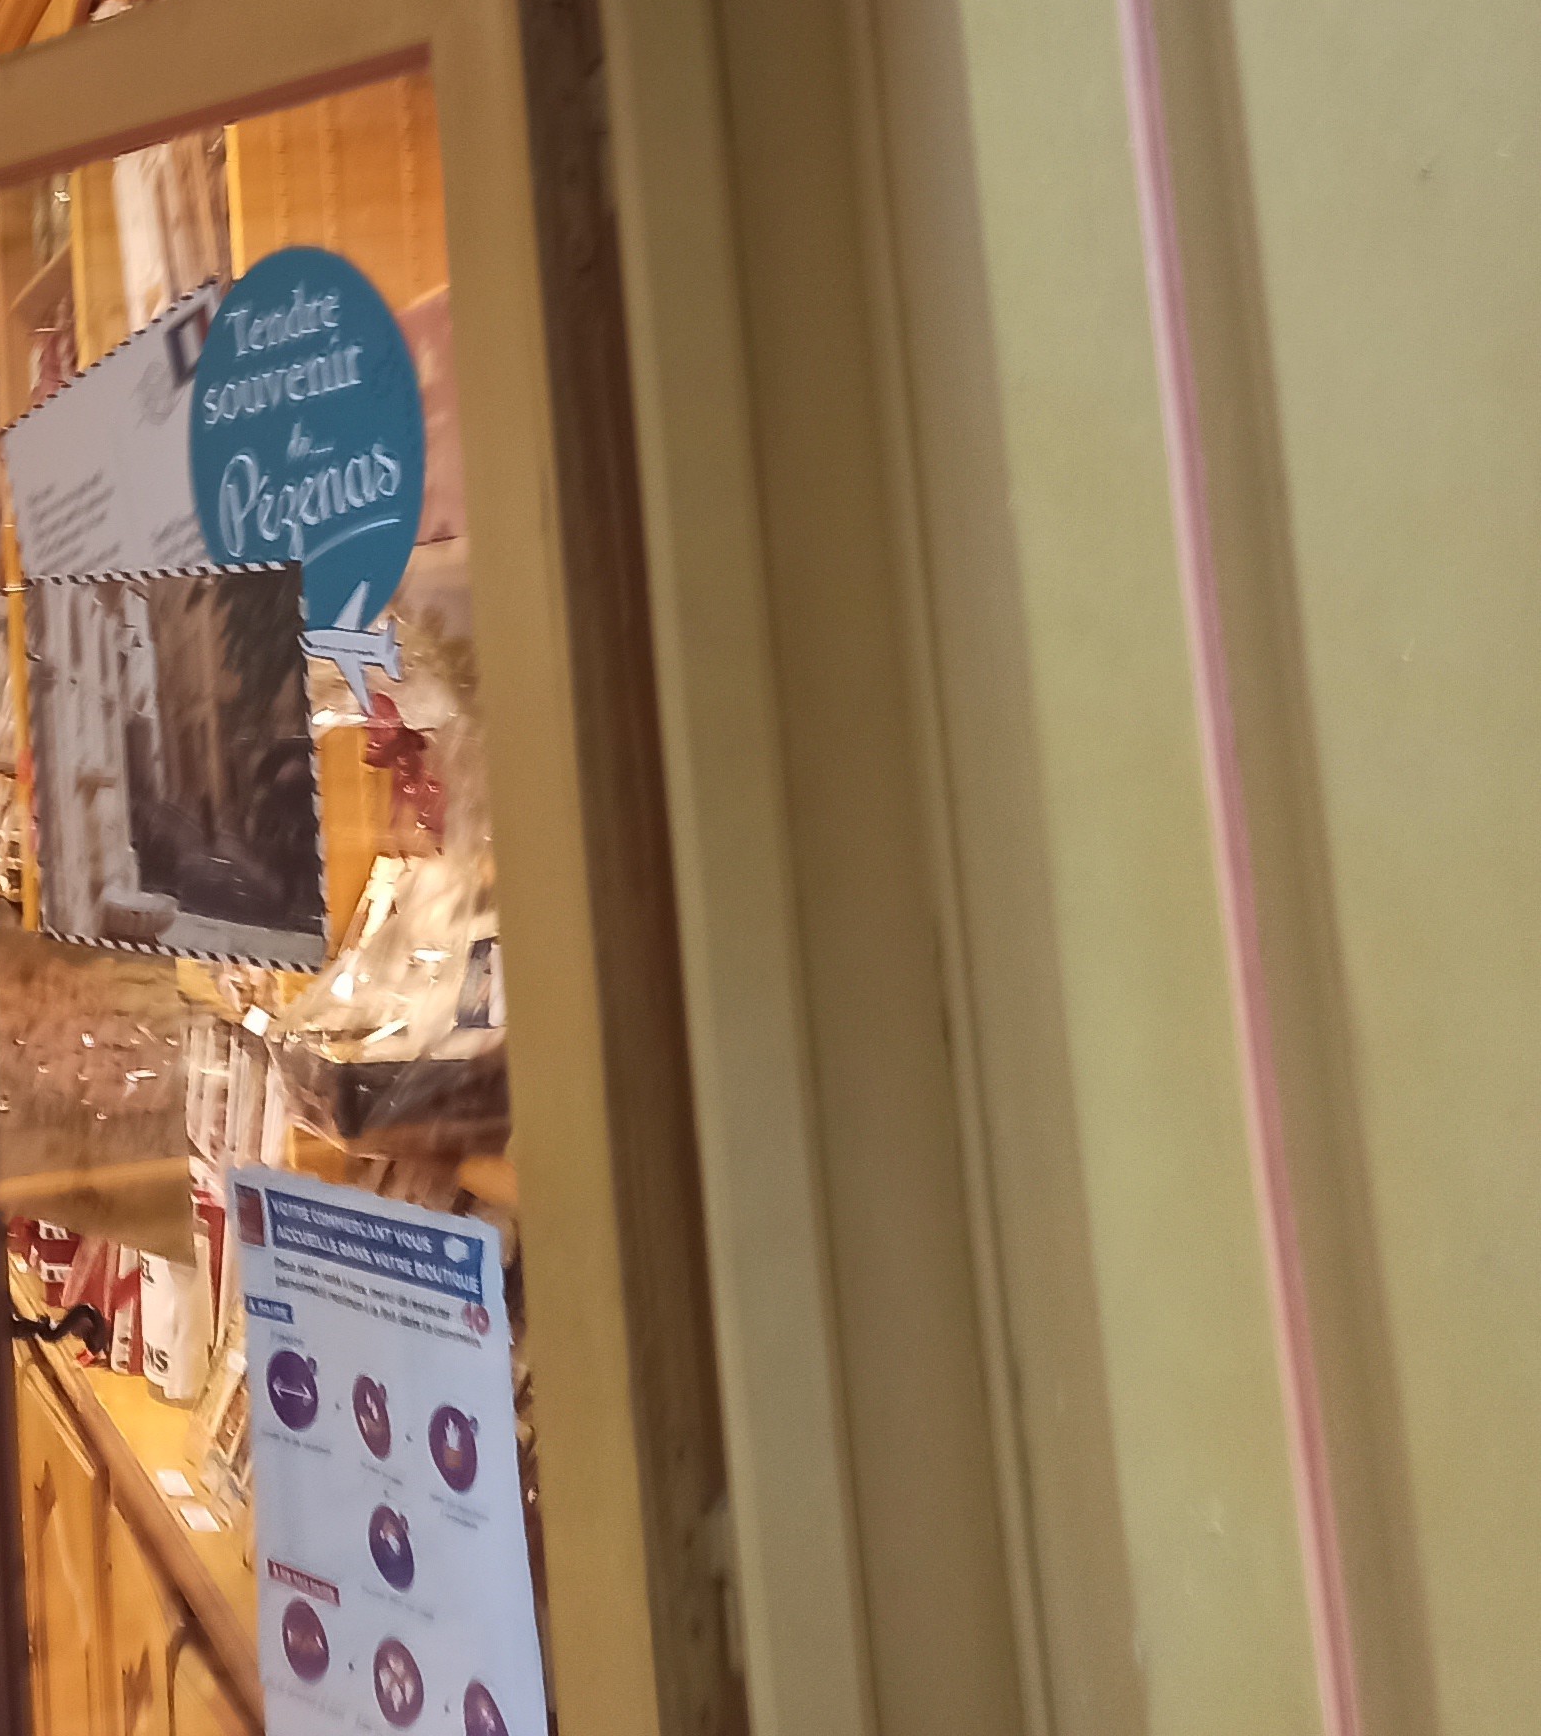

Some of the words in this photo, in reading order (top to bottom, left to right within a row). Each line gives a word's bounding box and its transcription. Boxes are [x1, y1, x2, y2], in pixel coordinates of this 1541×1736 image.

[225, 281, 341, 357] Tendre
[203, 333, 364, 428] souvenir
[394, 1229, 433, 1254] VOUS
